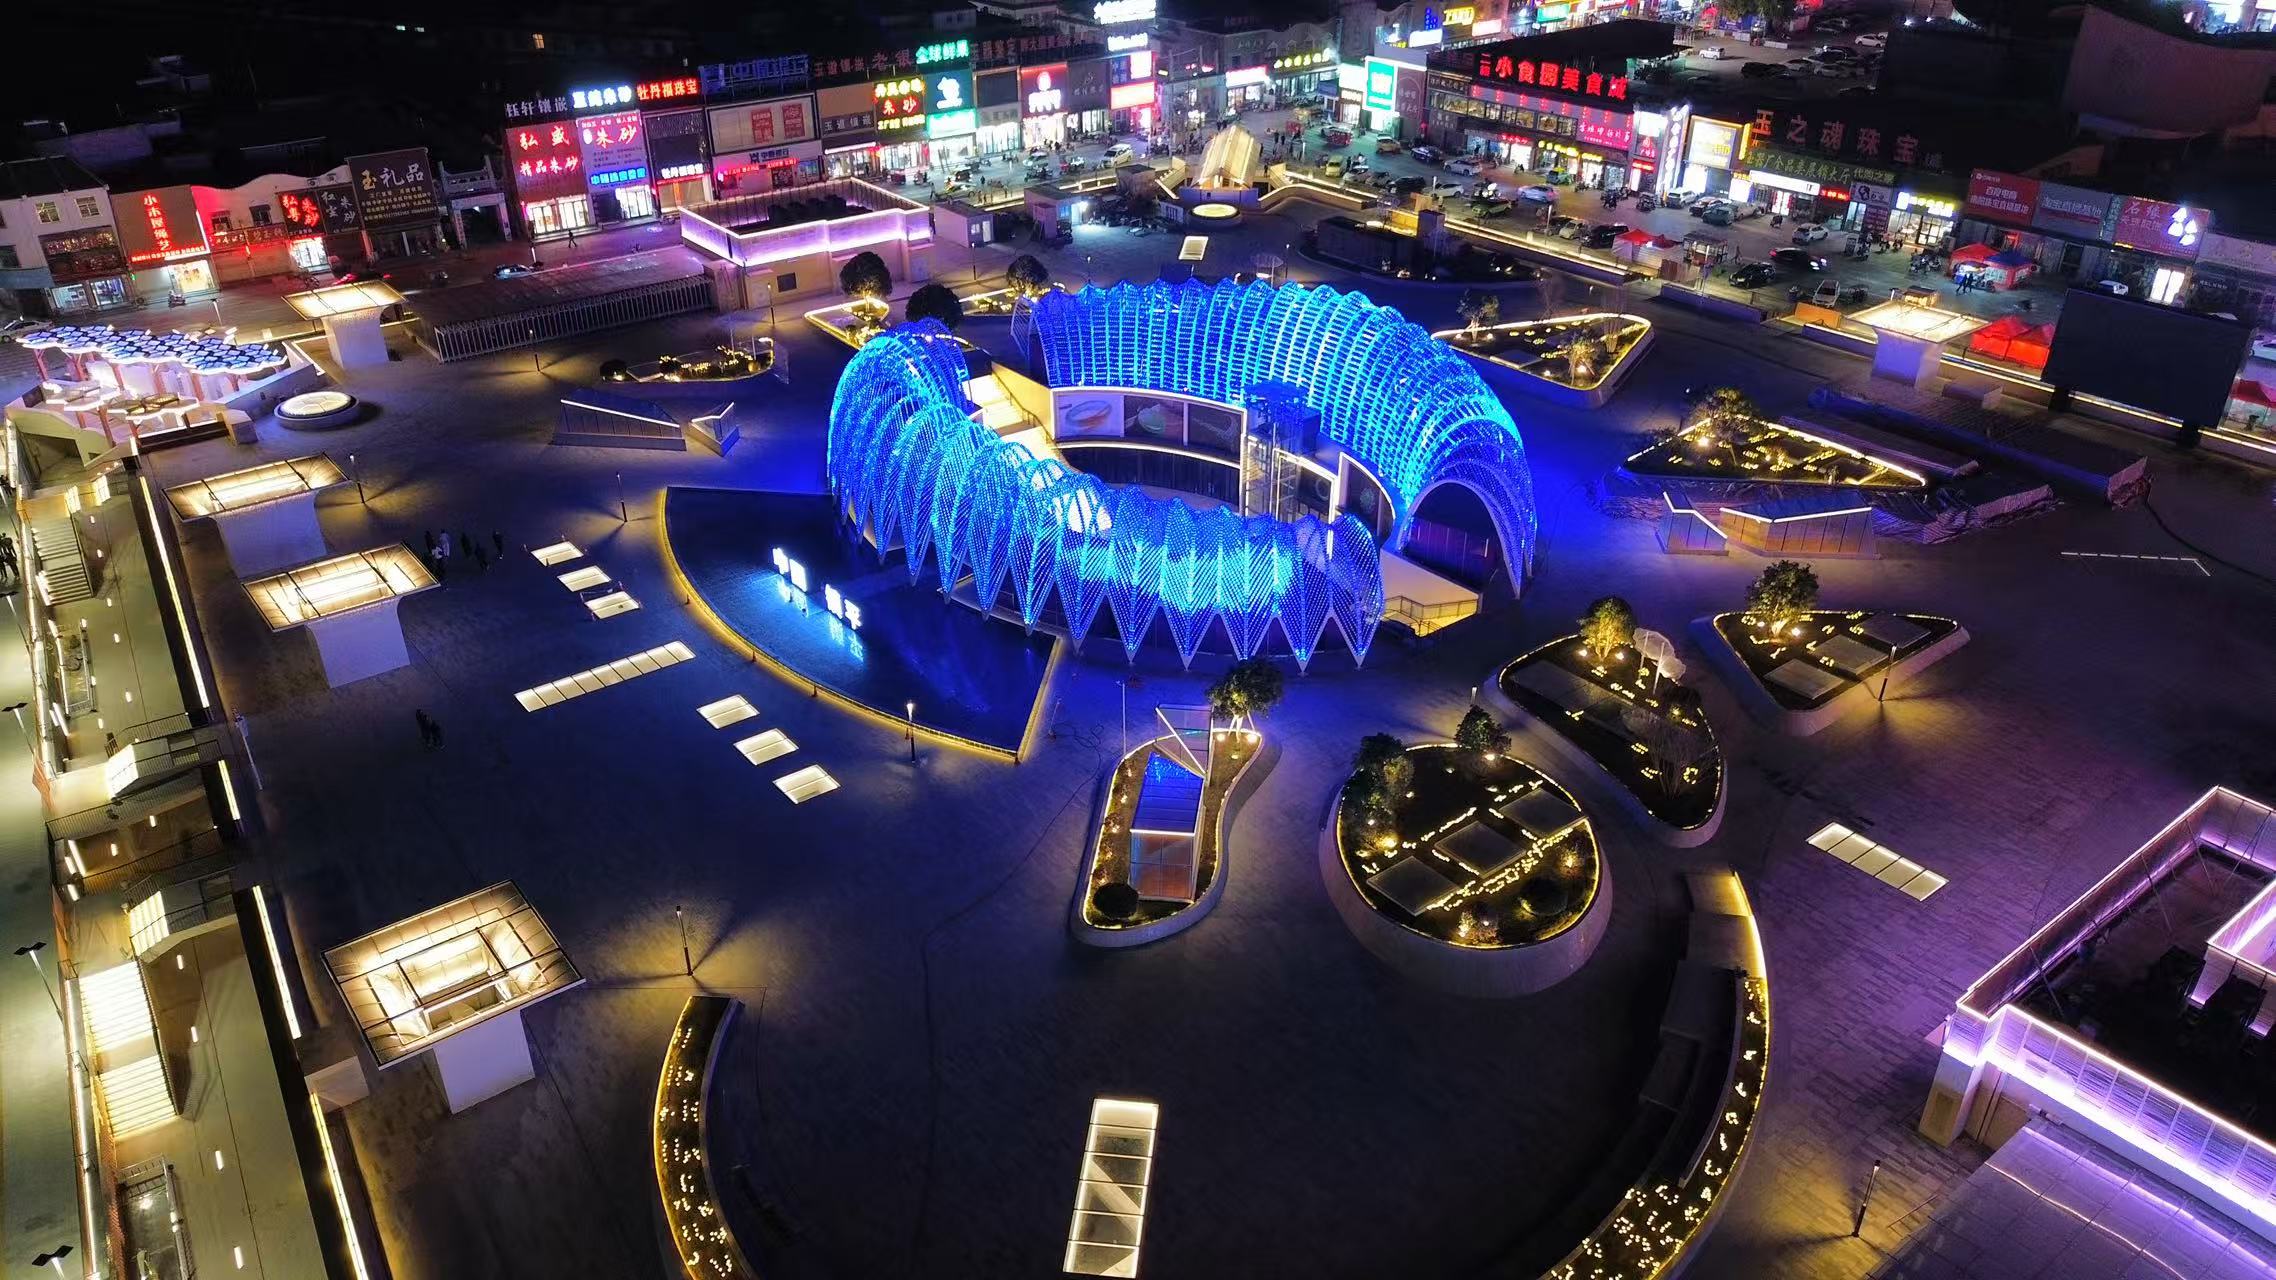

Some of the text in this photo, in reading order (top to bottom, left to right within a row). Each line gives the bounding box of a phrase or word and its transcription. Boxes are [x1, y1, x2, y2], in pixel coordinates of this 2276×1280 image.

[637, 78, 698, 100] 牡丹福珠宝
[883, 96, 917, 115] 朱砂
[519, 126, 570, 150] 弘盛
[596, 124, 637, 148] 朱砂
[519, 156, 579, 176] 精品朱砂
